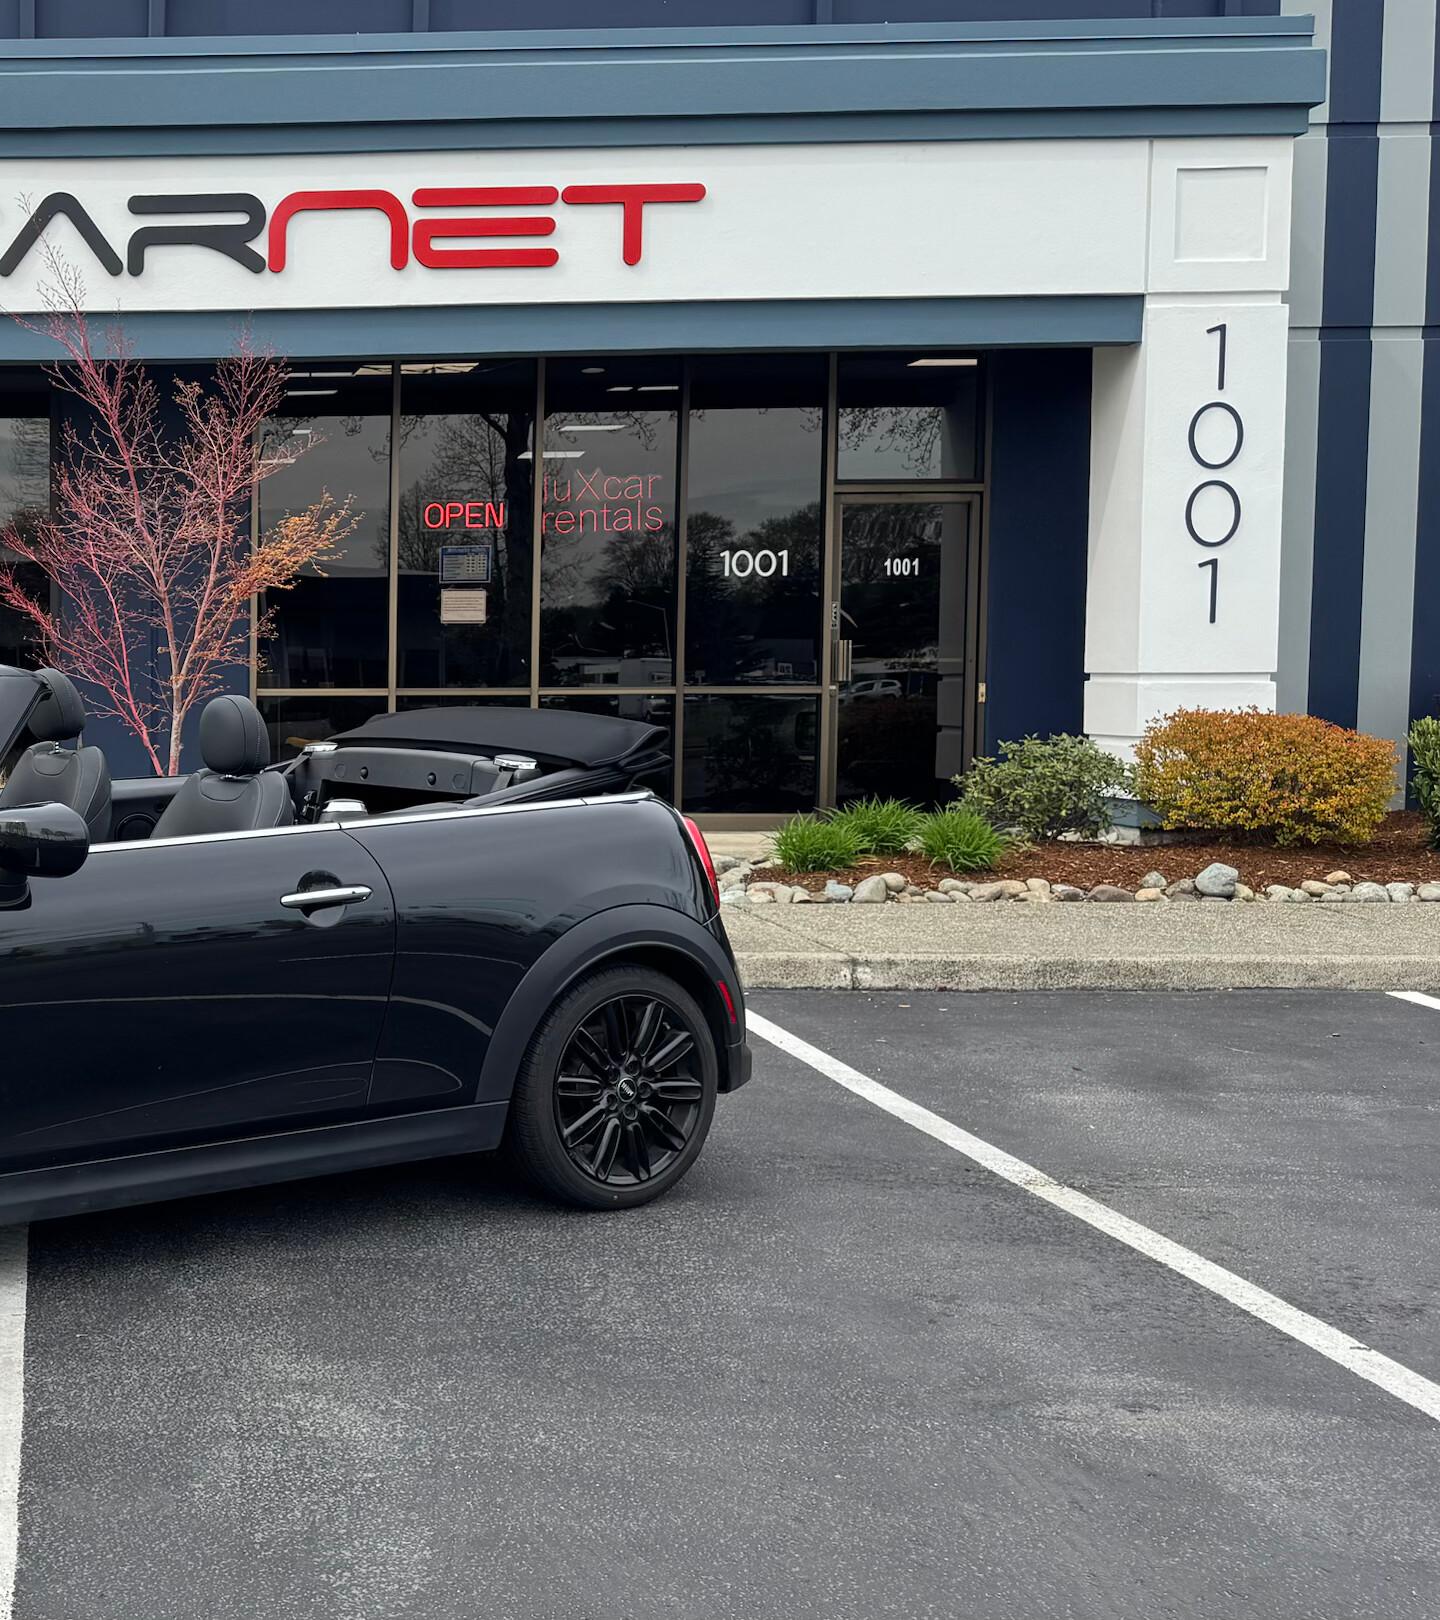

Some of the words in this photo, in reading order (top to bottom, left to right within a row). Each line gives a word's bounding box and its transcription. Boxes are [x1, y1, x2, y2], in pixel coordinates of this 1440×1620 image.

[1185, 323, 1244, 624] 1001
[423, 502, 505, 529] OPEN
[542, 500, 664, 535] rentals
[719, 549, 789, 577] 1001
[883, 558, 920, 577] 1001
